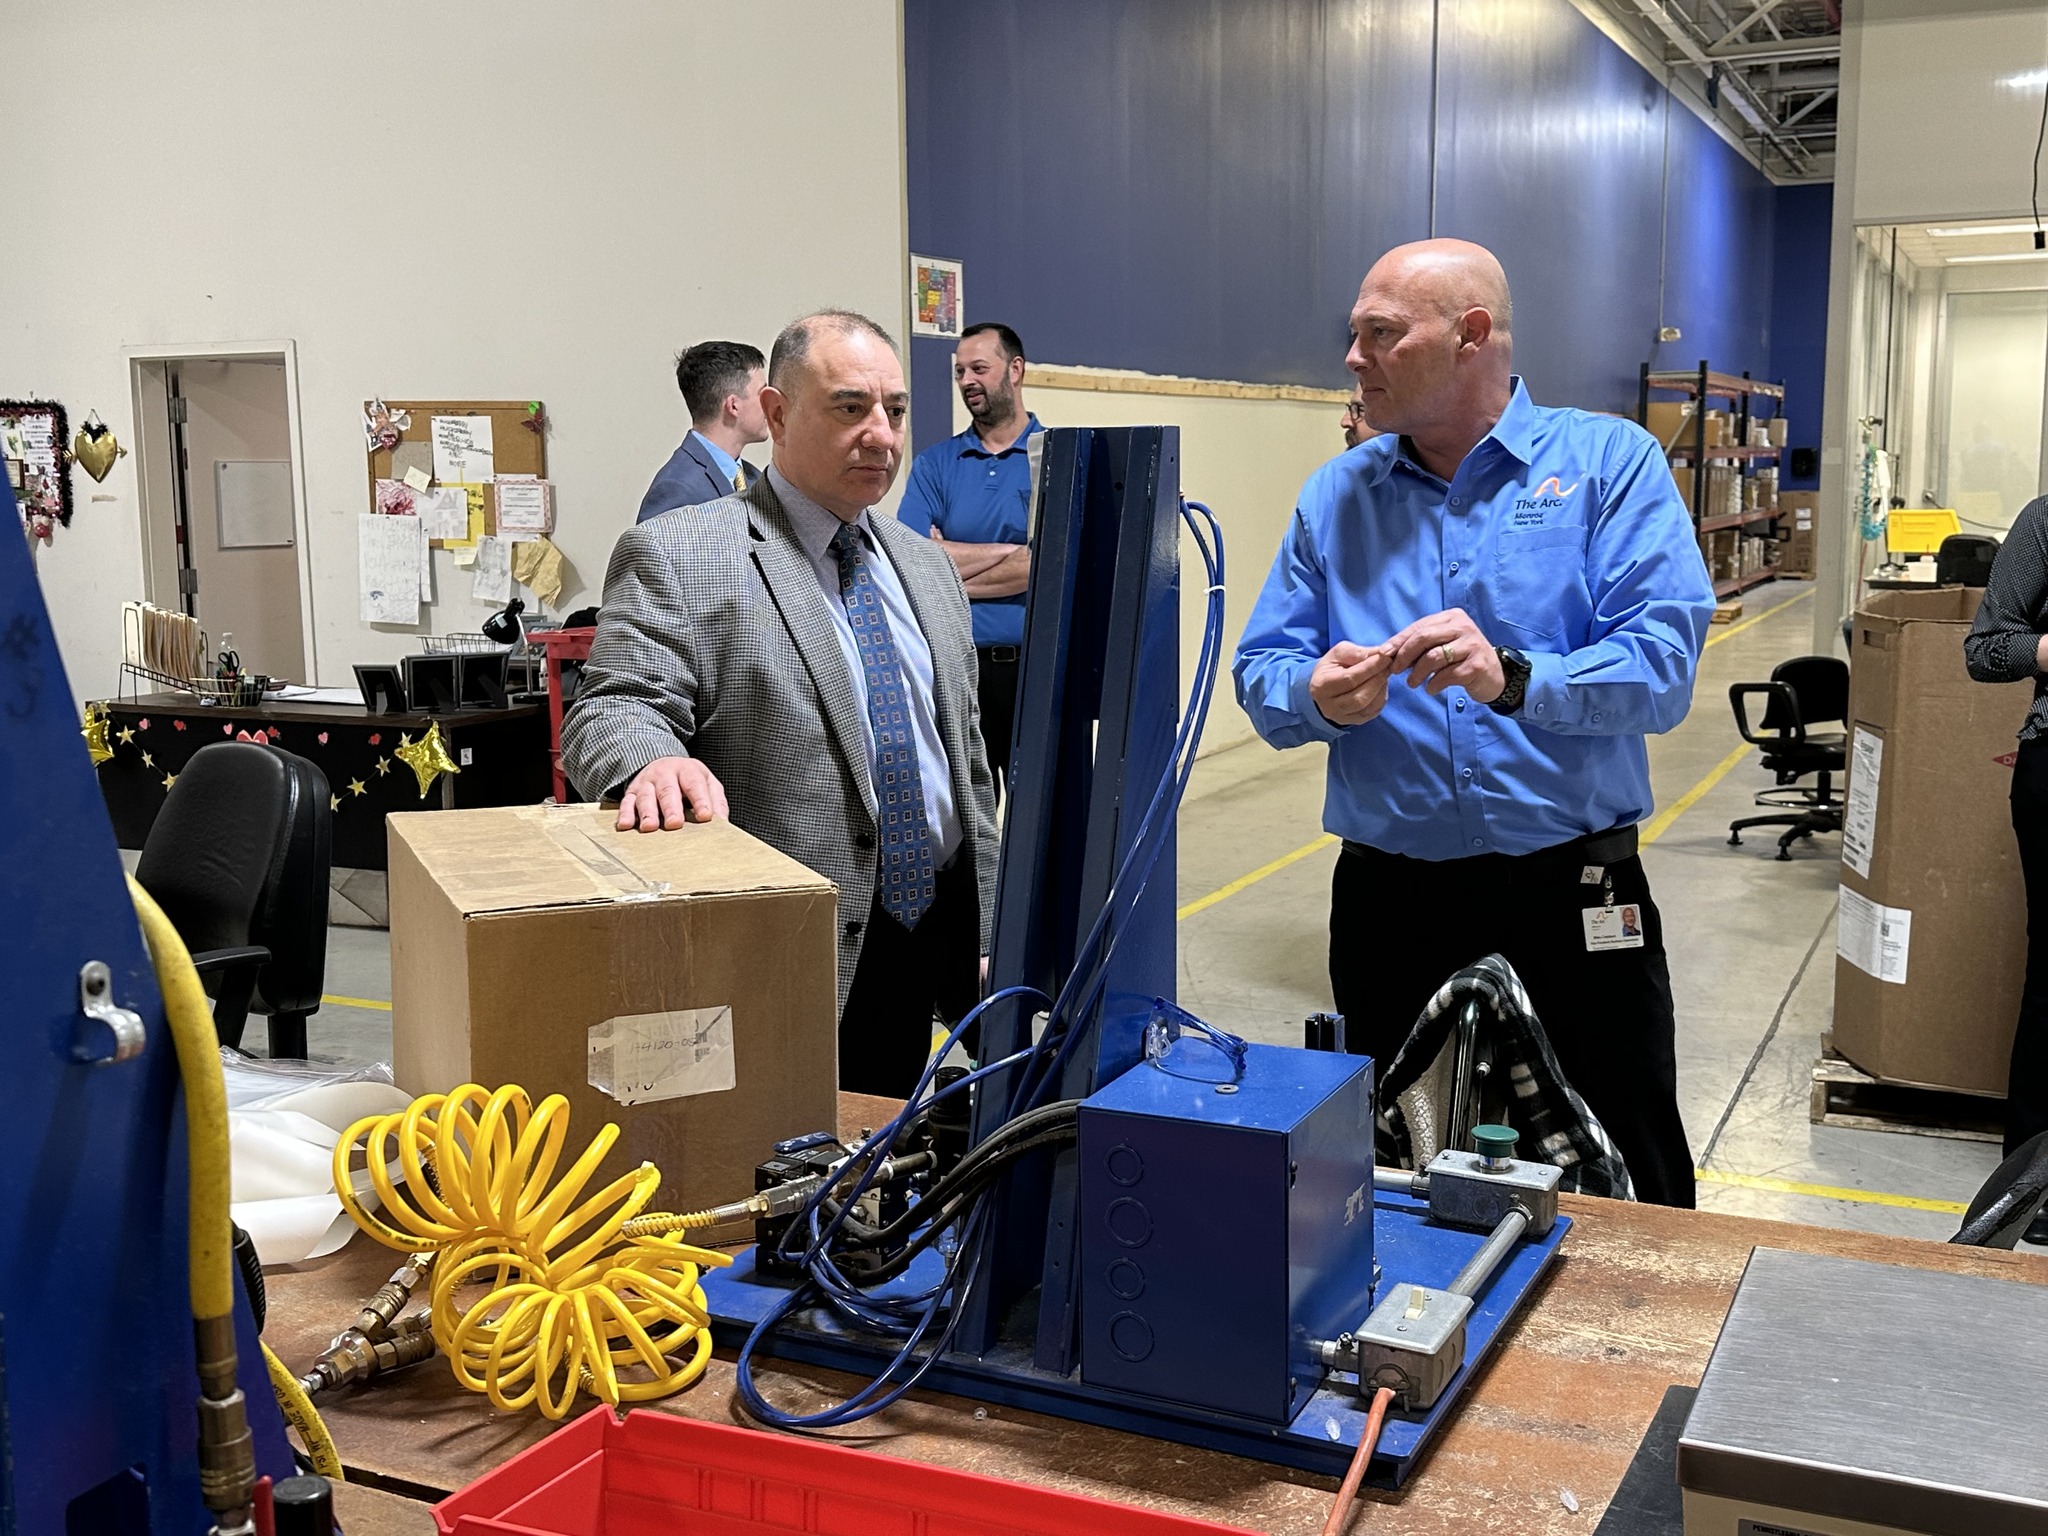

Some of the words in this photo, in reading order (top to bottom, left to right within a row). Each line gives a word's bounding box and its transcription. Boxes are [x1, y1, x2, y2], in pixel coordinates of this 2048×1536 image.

[1516, 499, 1537, 510] The
[272, 1383, 287, 1400] USA
[282, 1400, 294, 1410] IN
[315, 1455, 328, 1469] PSI
